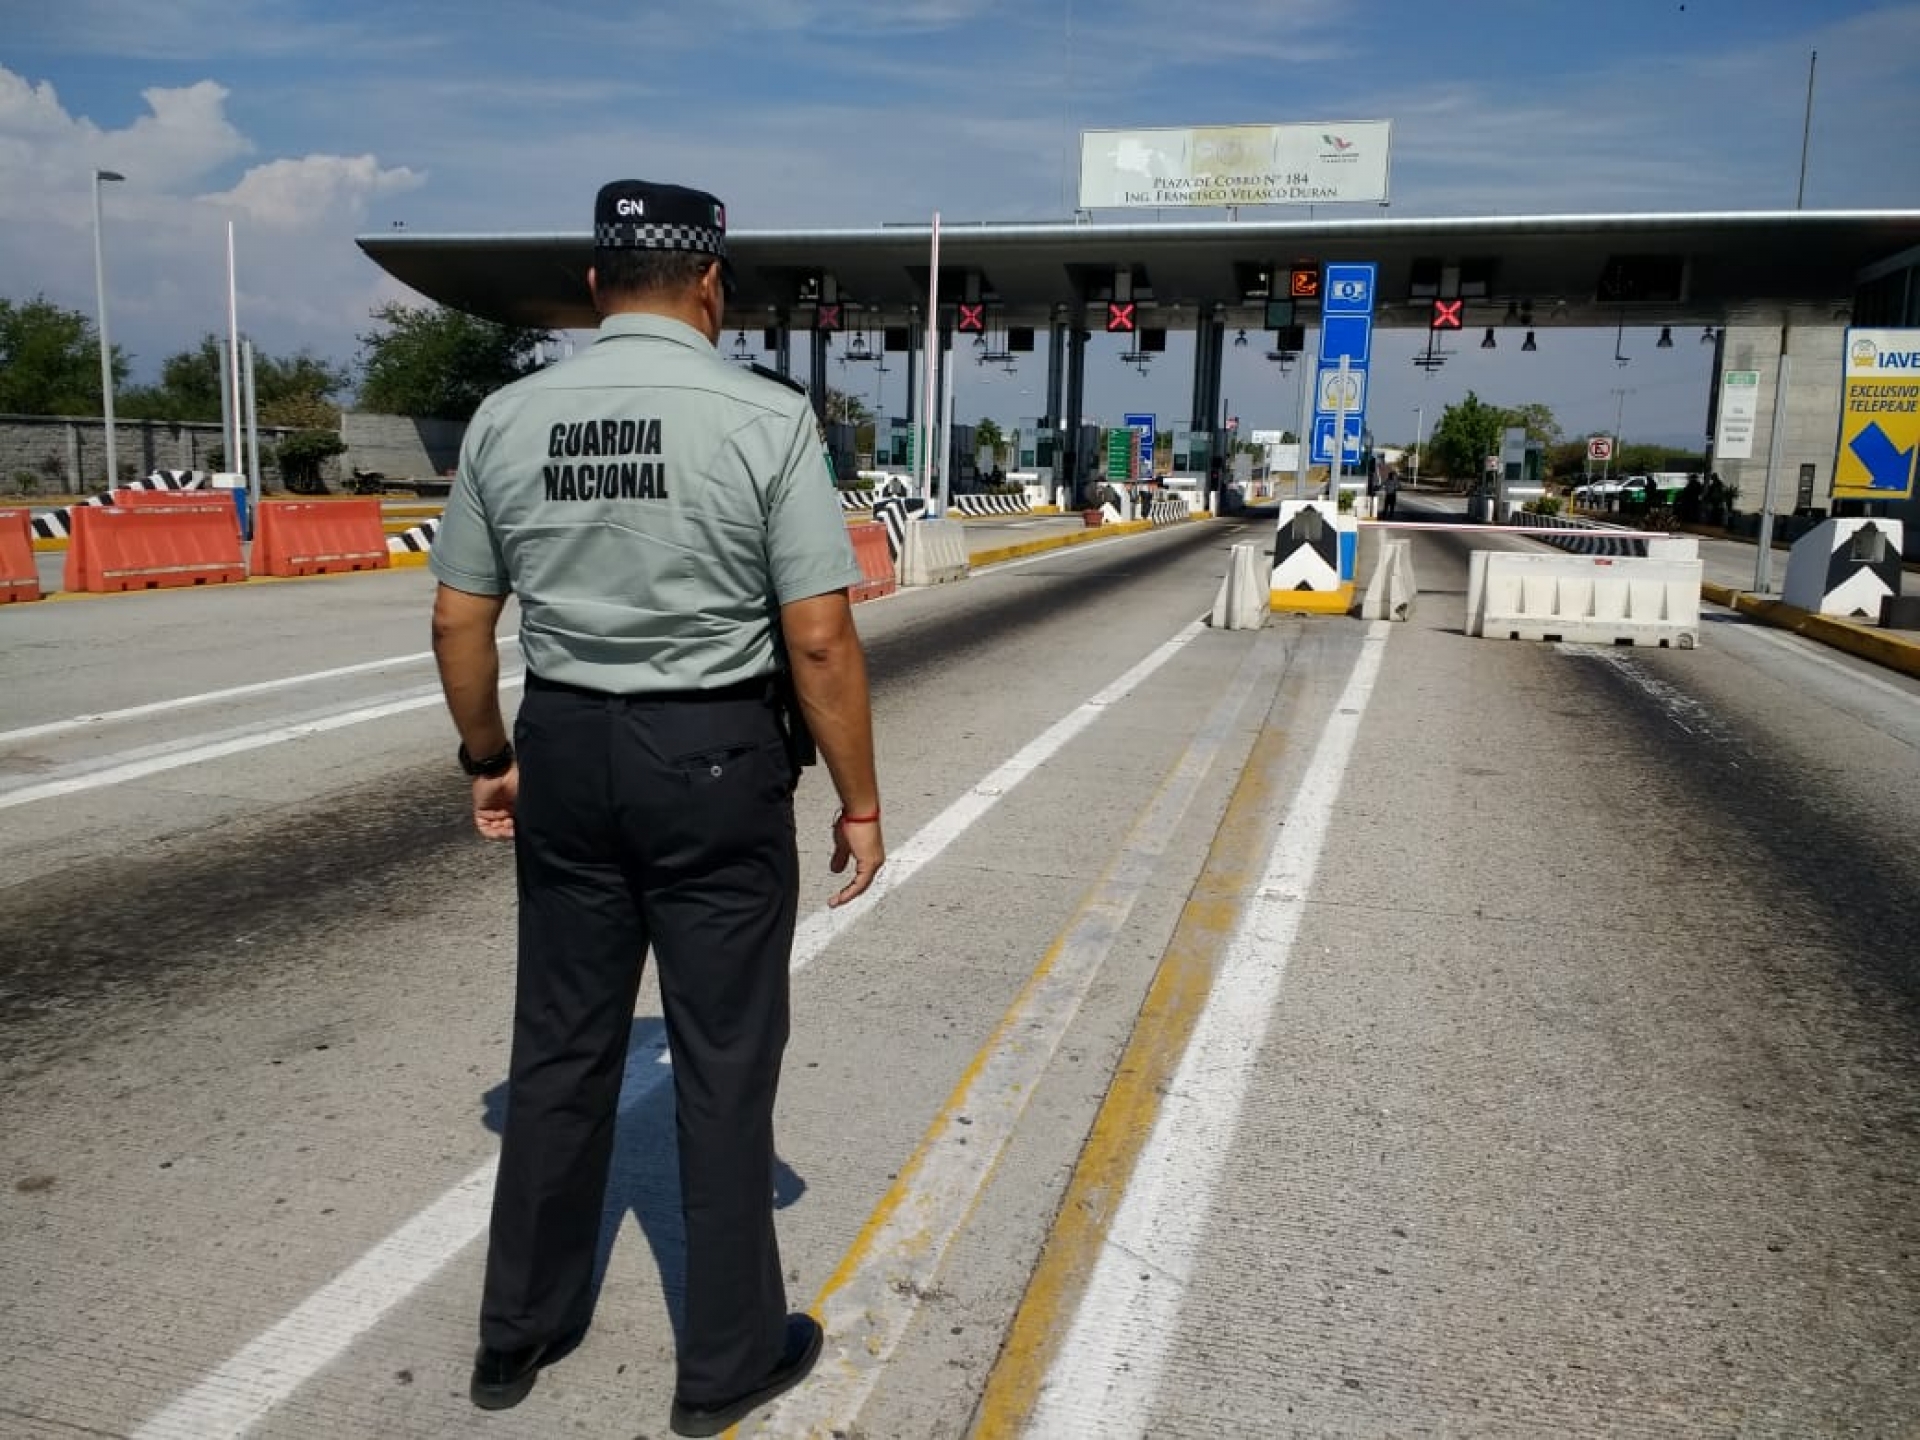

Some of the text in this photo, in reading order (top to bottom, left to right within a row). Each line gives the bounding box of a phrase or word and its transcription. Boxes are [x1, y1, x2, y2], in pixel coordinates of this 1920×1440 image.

[1152, 175, 1190, 188] PLAZA
[1194, 176, 1211, 187] DE
[1214, 174, 1260, 187] COBRO
[1286, 172, 1309, 185] 184
[1156, 189, 1227, 202] FRANCISCO
[1231, 187, 1287, 200] VELASCO
[616, 198, 644, 216] GN
[1878, 352, 1920, 368] IAVE
[1850, 385, 1919, 398] EXCLUSIVO
[1849, 400, 1918, 413] TELEPEAJE
[548, 418, 662, 458] GUARDIA
[543, 462, 669, 501] NACIONAL
